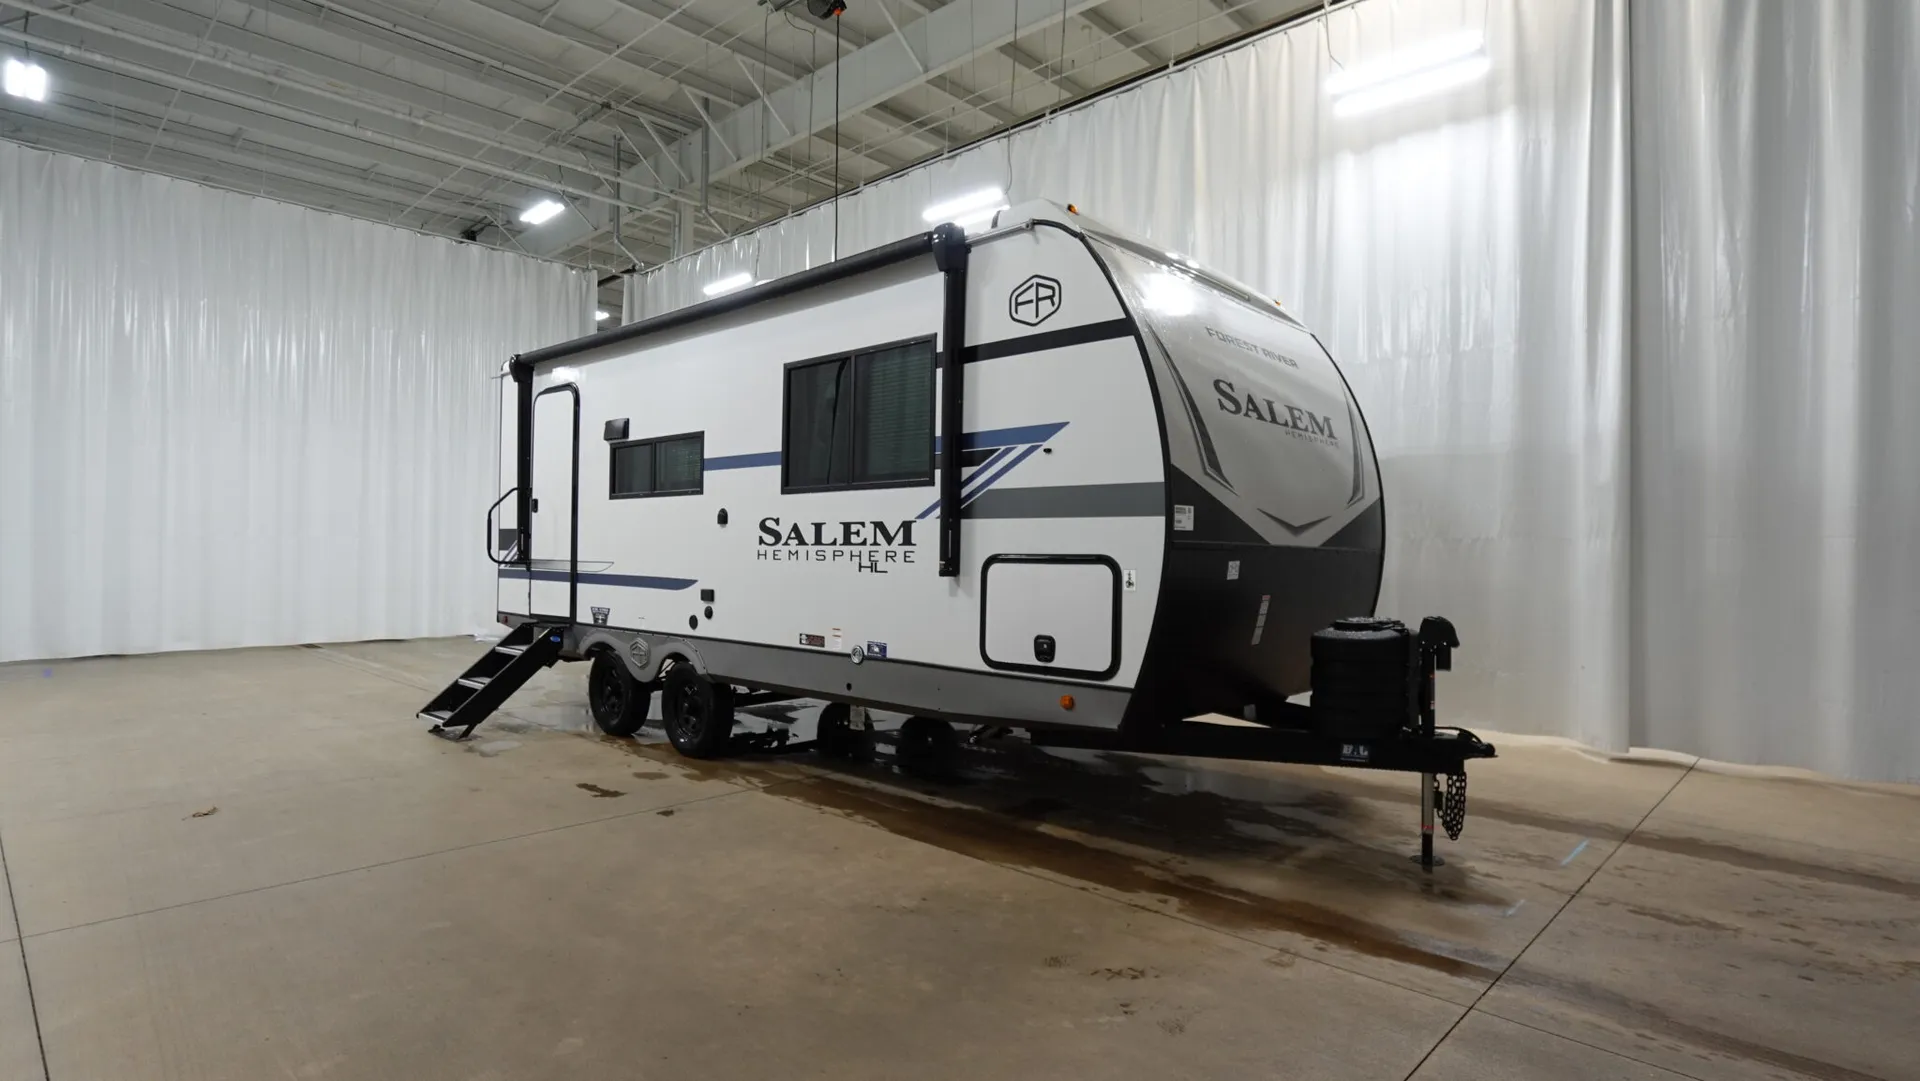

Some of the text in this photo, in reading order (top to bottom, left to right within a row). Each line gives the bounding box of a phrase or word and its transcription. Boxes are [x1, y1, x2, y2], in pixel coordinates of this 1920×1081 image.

[1015, 282, 1056, 319] FR
[1206, 327, 1300, 370] FOREST RIVER
[1213, 378, 1339, 440] SALEM
[758, 517, 917, 547] SALEM
[757, 549, 915, 563] HEMISPHERE
[858, 561, 888, 573] HL
